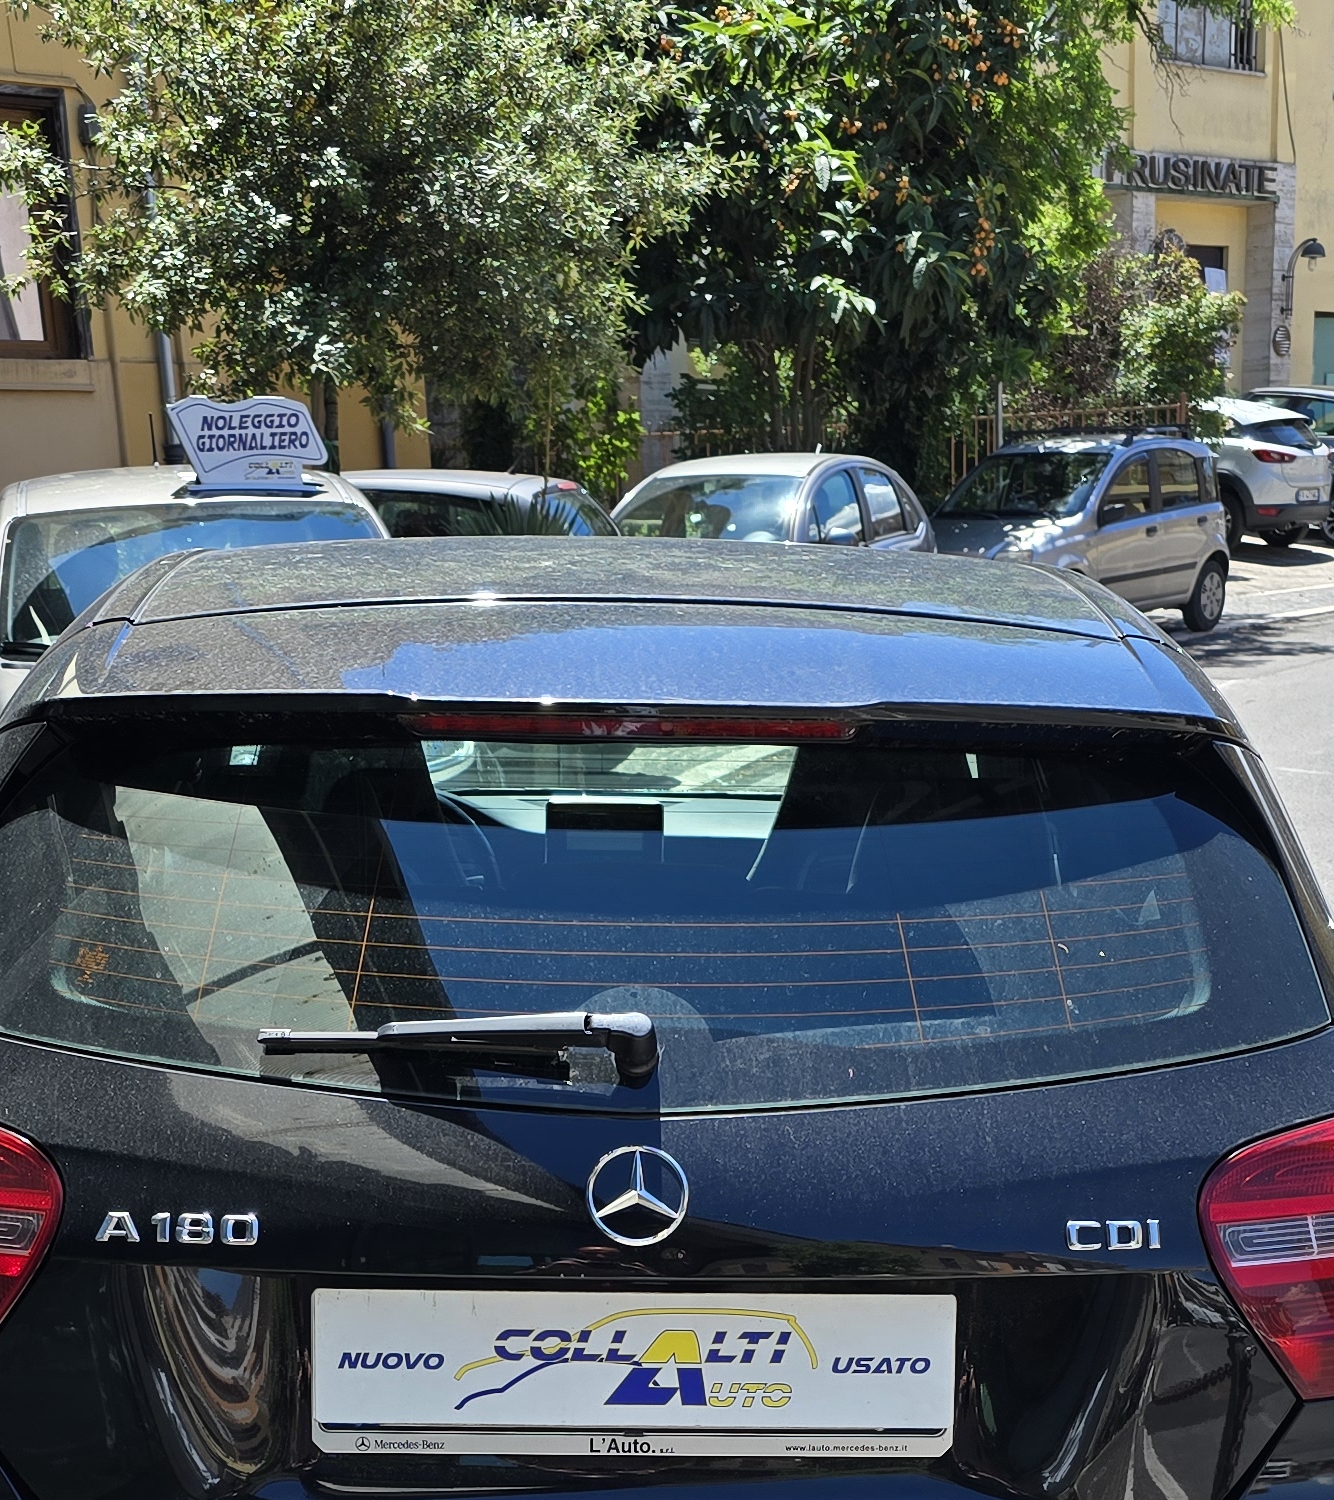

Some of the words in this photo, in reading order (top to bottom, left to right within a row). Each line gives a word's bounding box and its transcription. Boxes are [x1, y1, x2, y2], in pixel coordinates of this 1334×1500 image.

[200, 412, 300, 432] NOLEGGIO
[196, 431, 310, 453] GIORNALIERO
[95, 1211, 140, 1243] A
[150, 1211, 259, 1246] 180
[1066, 1219, 1161, 1251] CDI
[337, 1352, 445, 1370] NUOVO
[831, 1357, 931, 1374] USATO
[373, 1438, 445, 1451] Mercedes-Benz
[785, 1444, 908, 1452] www.lauto.mercedes-benz.it
